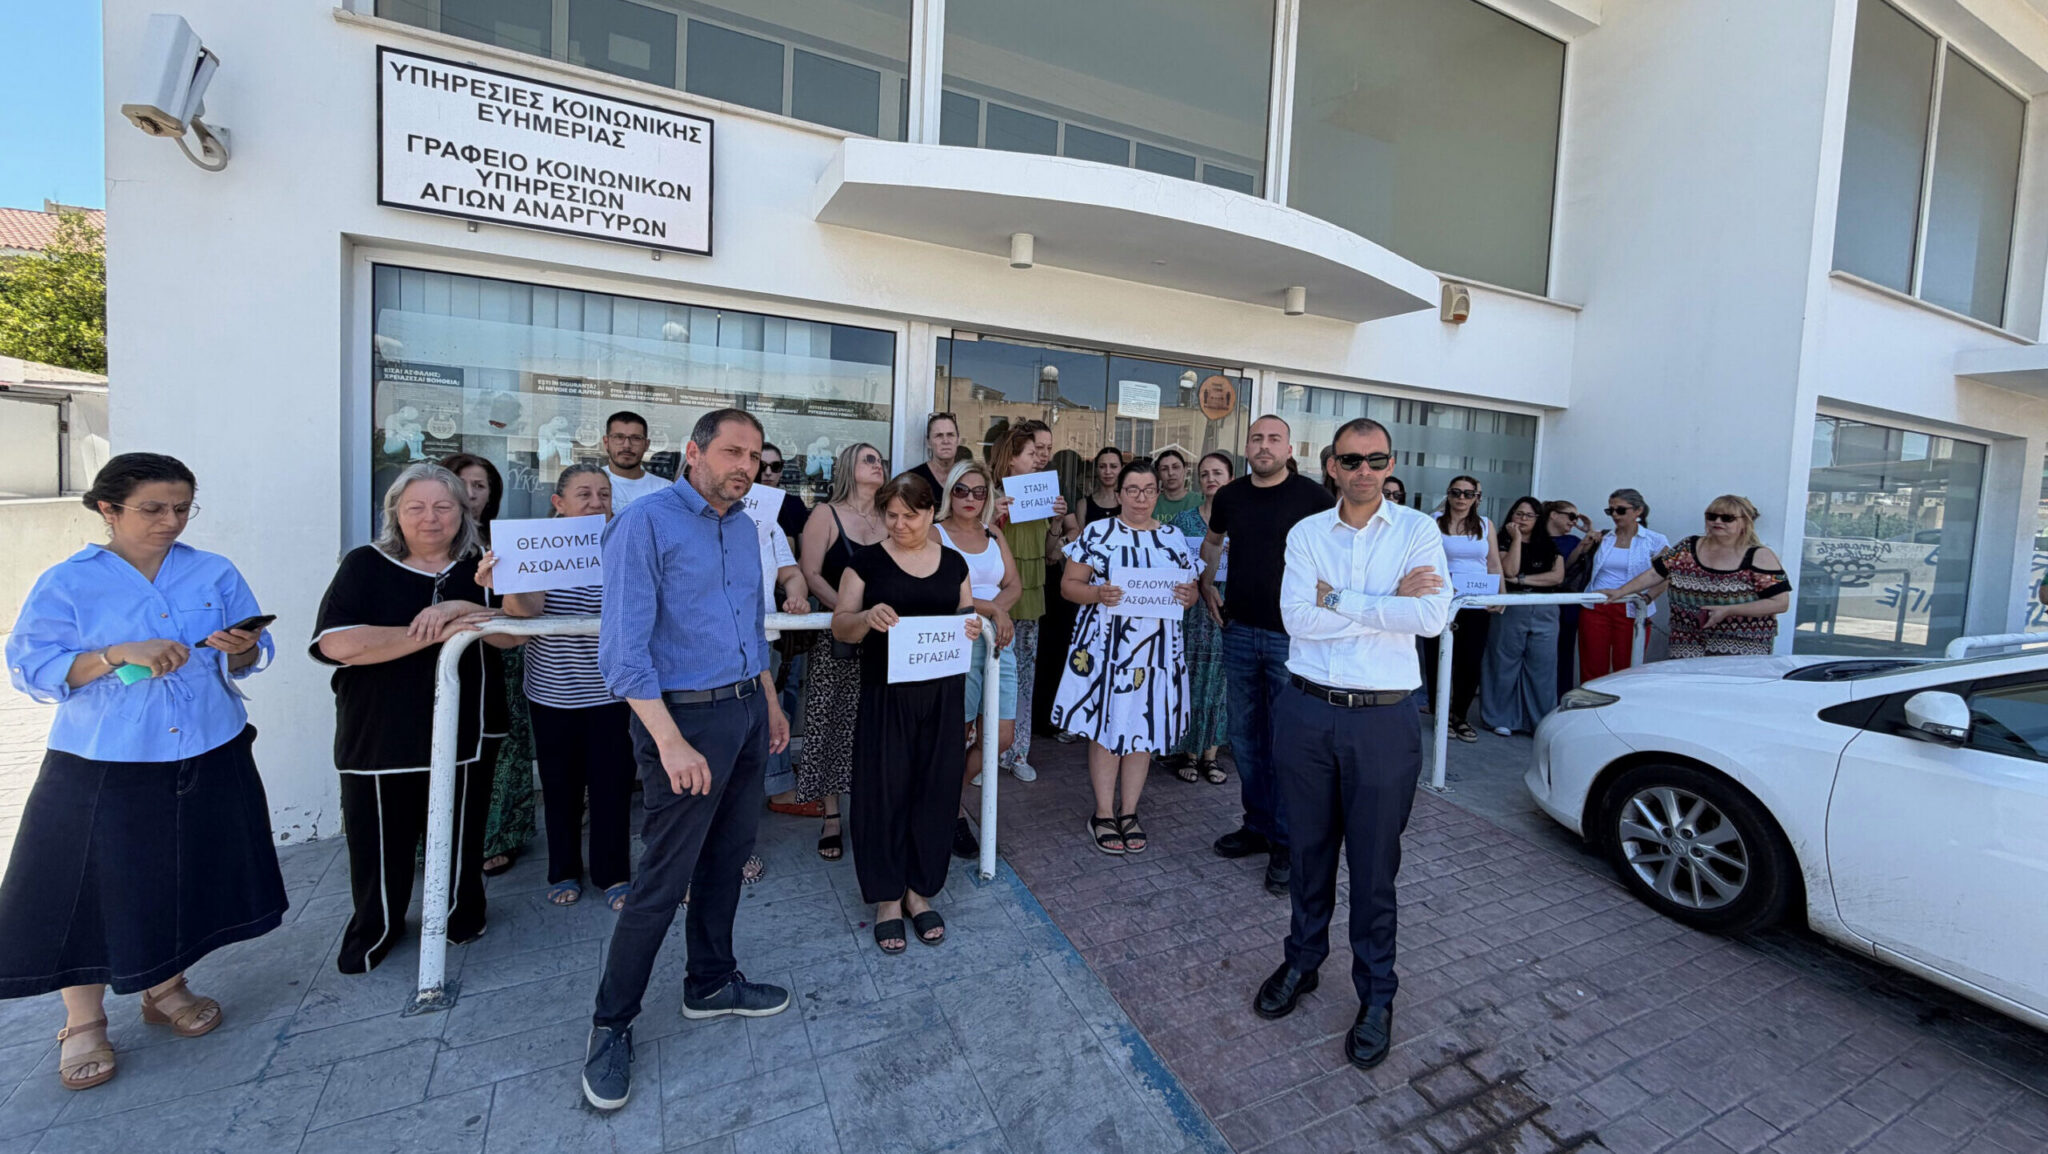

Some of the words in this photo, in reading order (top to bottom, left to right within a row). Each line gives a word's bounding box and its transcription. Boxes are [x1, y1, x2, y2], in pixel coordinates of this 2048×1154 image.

[390, 61, 544, 110] ΥΠΗΡΕΣΙΕΣ
[553, 96, 702, 144] ΚΟΙΝΩΝΙΚΗΣ
[478, 103, 625, 148] ΕΥΗΜΕΡΙΑΣ
[407, 134, 528, 172] ΓΡΑΦΕΙΟ
[537, 158, 691, 202] ΚΟΙΝΩΝΙΚΩΝ
[476, 168, 624, 210] ΥΠΗΡΕΣΙΩΝ
[420, 182, 505, 212] ΑΓΙΩΝ
[513, 198, 666, 238] ΑΝΑΡΓΥΡΩΝ
[1024, 483, 1048, 494] ΣΤΑΣΗ
[517, 533, 599, 550] ΘΕΛΟΥΜΕ
[518, 556, 601, 574] ΑΣΦΑΛΕΙΑ
[1466, 581, 1488, 589] ΣΤΑΣΗ
[1124, 595, 1178, 606] ΑΣΦΑΛΕΙΑ
[917, 632, 956, 644] ΣΤΑΣΗ
[908, 648, 961, 665] ΕΡΓΑΣΙΑΣ
